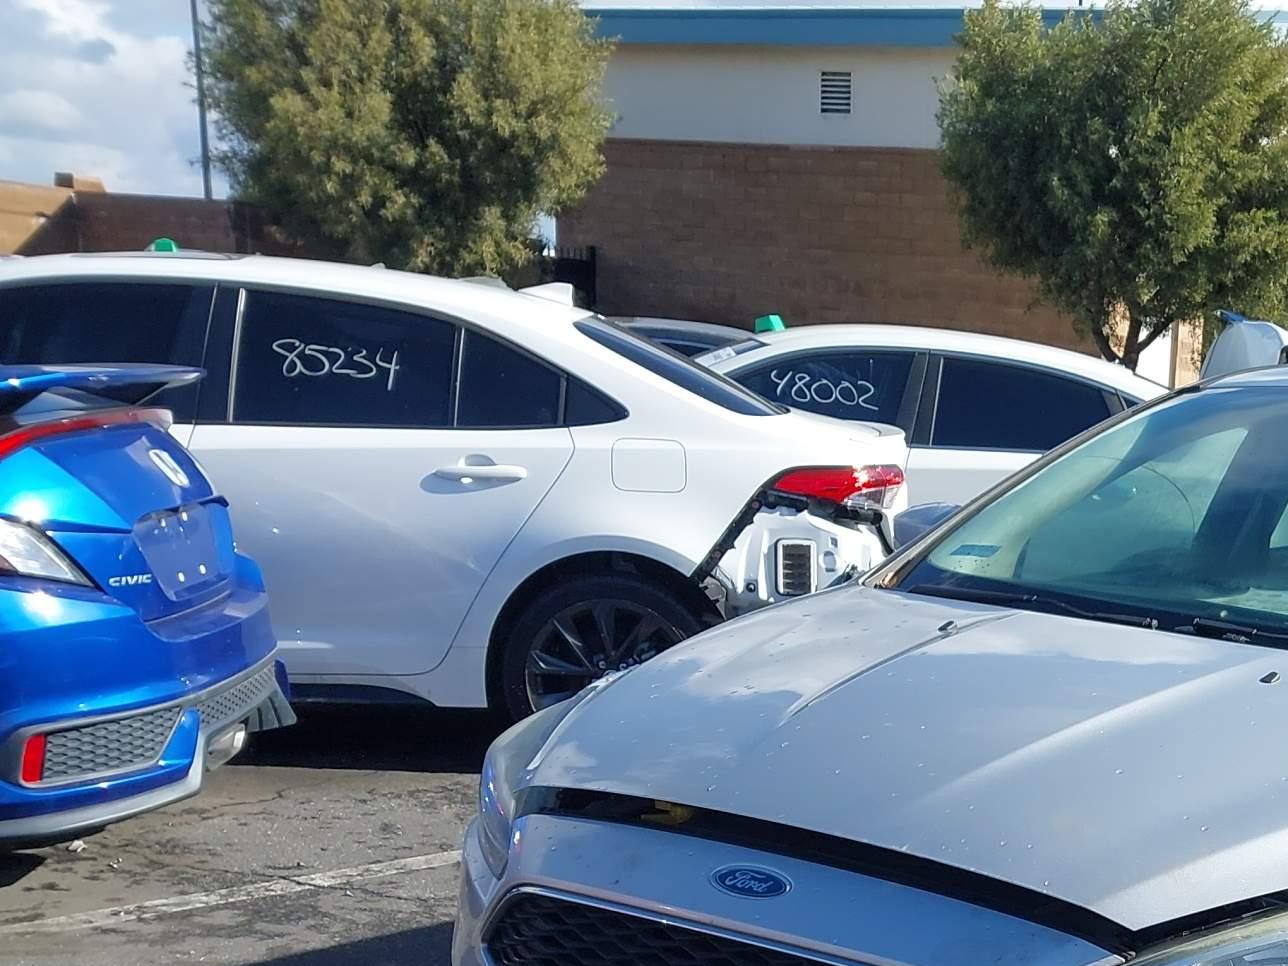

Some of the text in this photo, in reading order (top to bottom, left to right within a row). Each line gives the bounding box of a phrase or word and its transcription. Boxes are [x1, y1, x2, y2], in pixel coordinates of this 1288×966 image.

[272, 338, 400, 391] 85234
[770, 369, 879, 411] 48002
[108, 573, 152, 587] CIVIC
[725, 870, 774, 892] Ford
